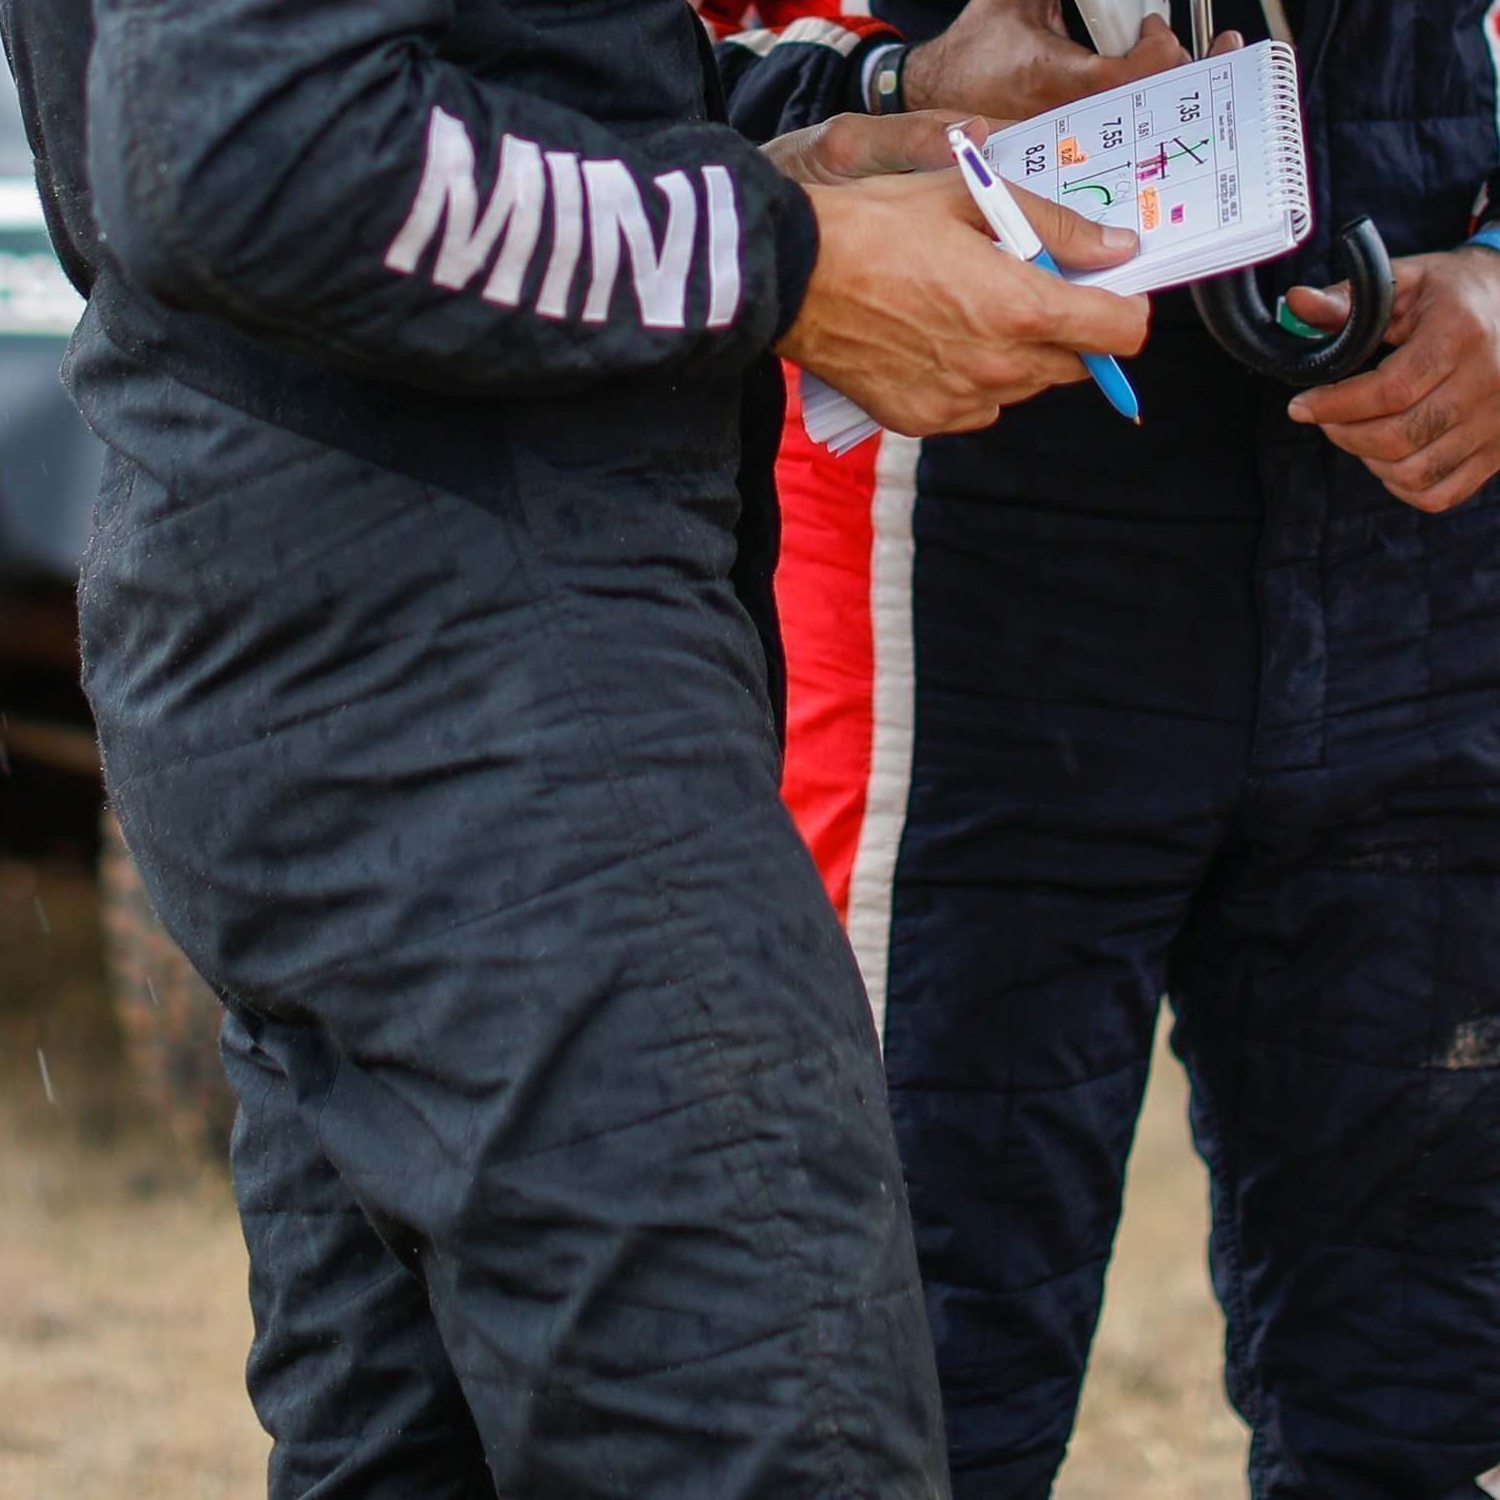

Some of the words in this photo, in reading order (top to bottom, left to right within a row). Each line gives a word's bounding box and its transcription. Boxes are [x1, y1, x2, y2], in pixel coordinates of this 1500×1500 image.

[1176, 91, 1200, 122] 7,35
[1098, 116, 1123, 149] 7,55
[1137, 122, 1150, 138] 0,61
[1021, 143, 1046, 176] 8,22
[384, 104, 742, 328] MINI
